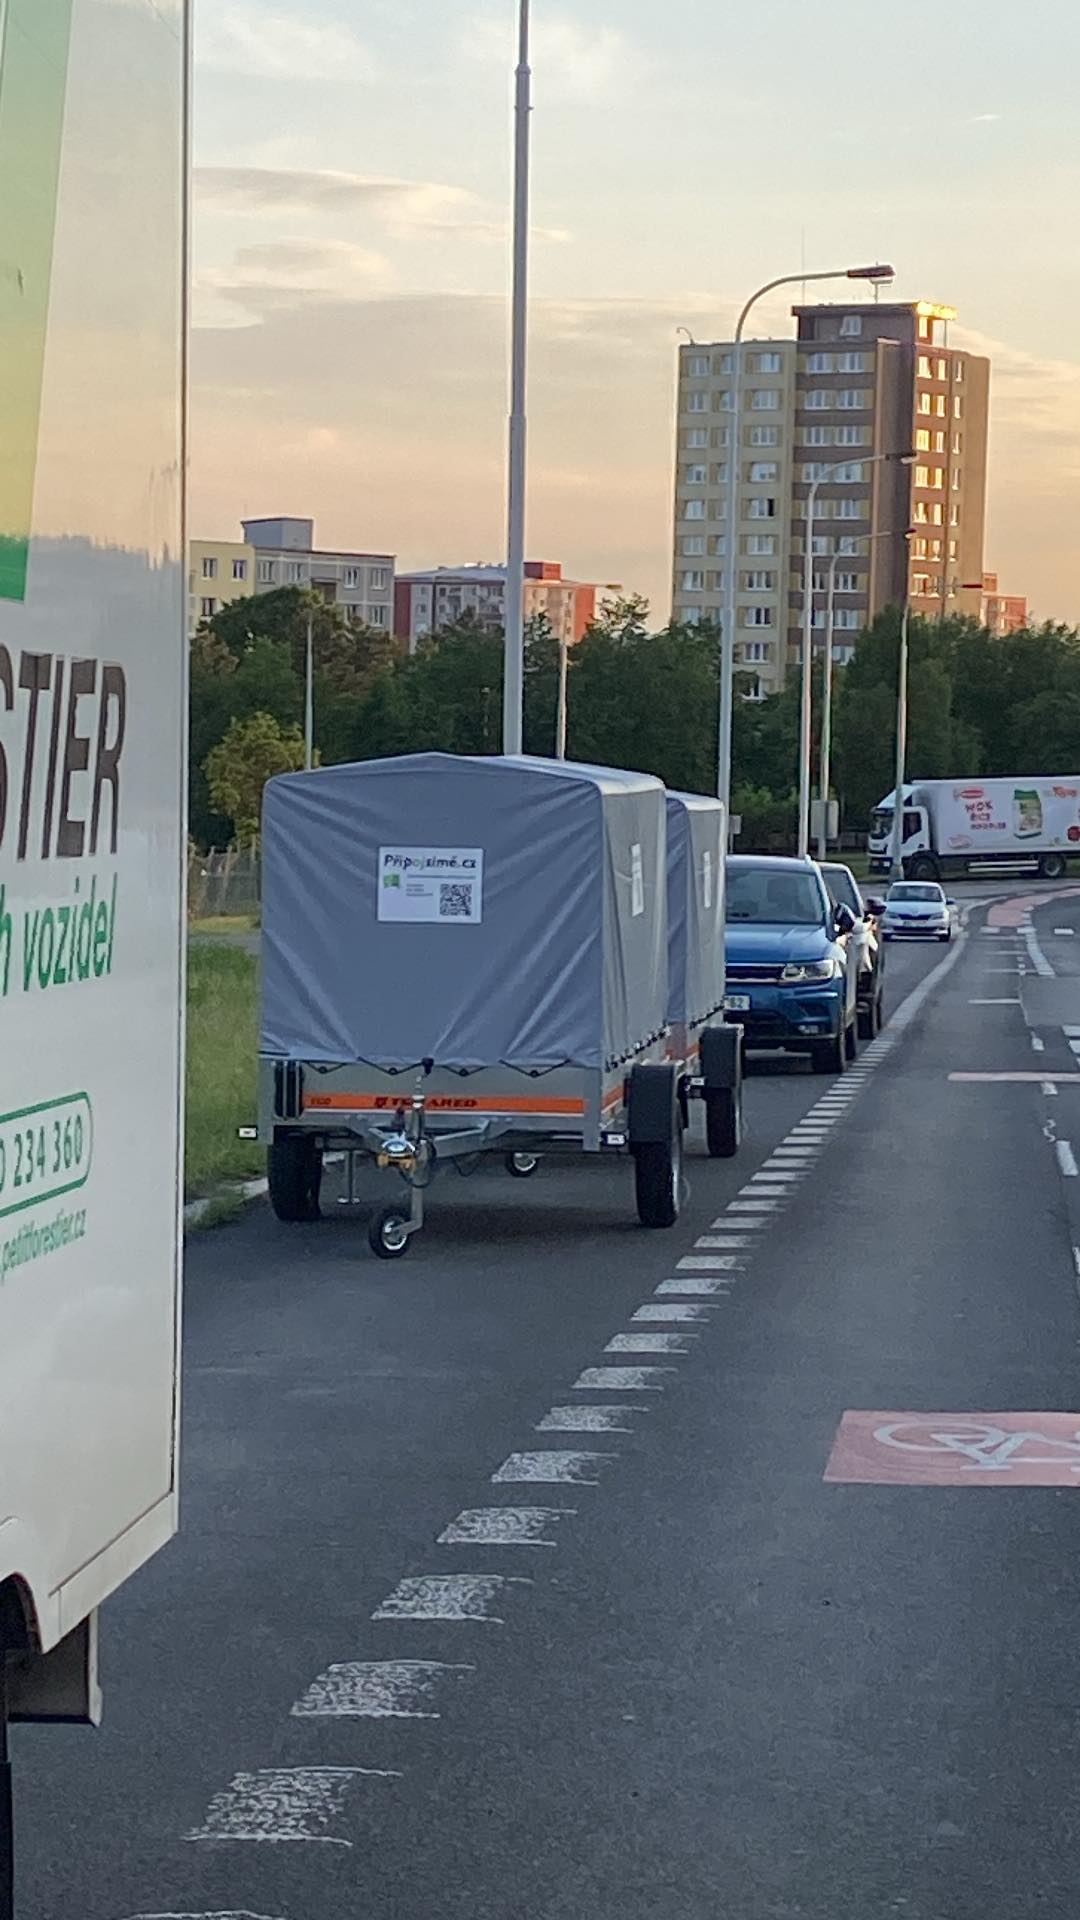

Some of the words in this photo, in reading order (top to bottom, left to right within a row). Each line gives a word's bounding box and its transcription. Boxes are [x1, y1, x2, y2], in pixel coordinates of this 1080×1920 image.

[24, 872, 117, 992] vozidel
[13, 1126, 46, 1187] 234
[53, 1114, 83, 1173] 360
